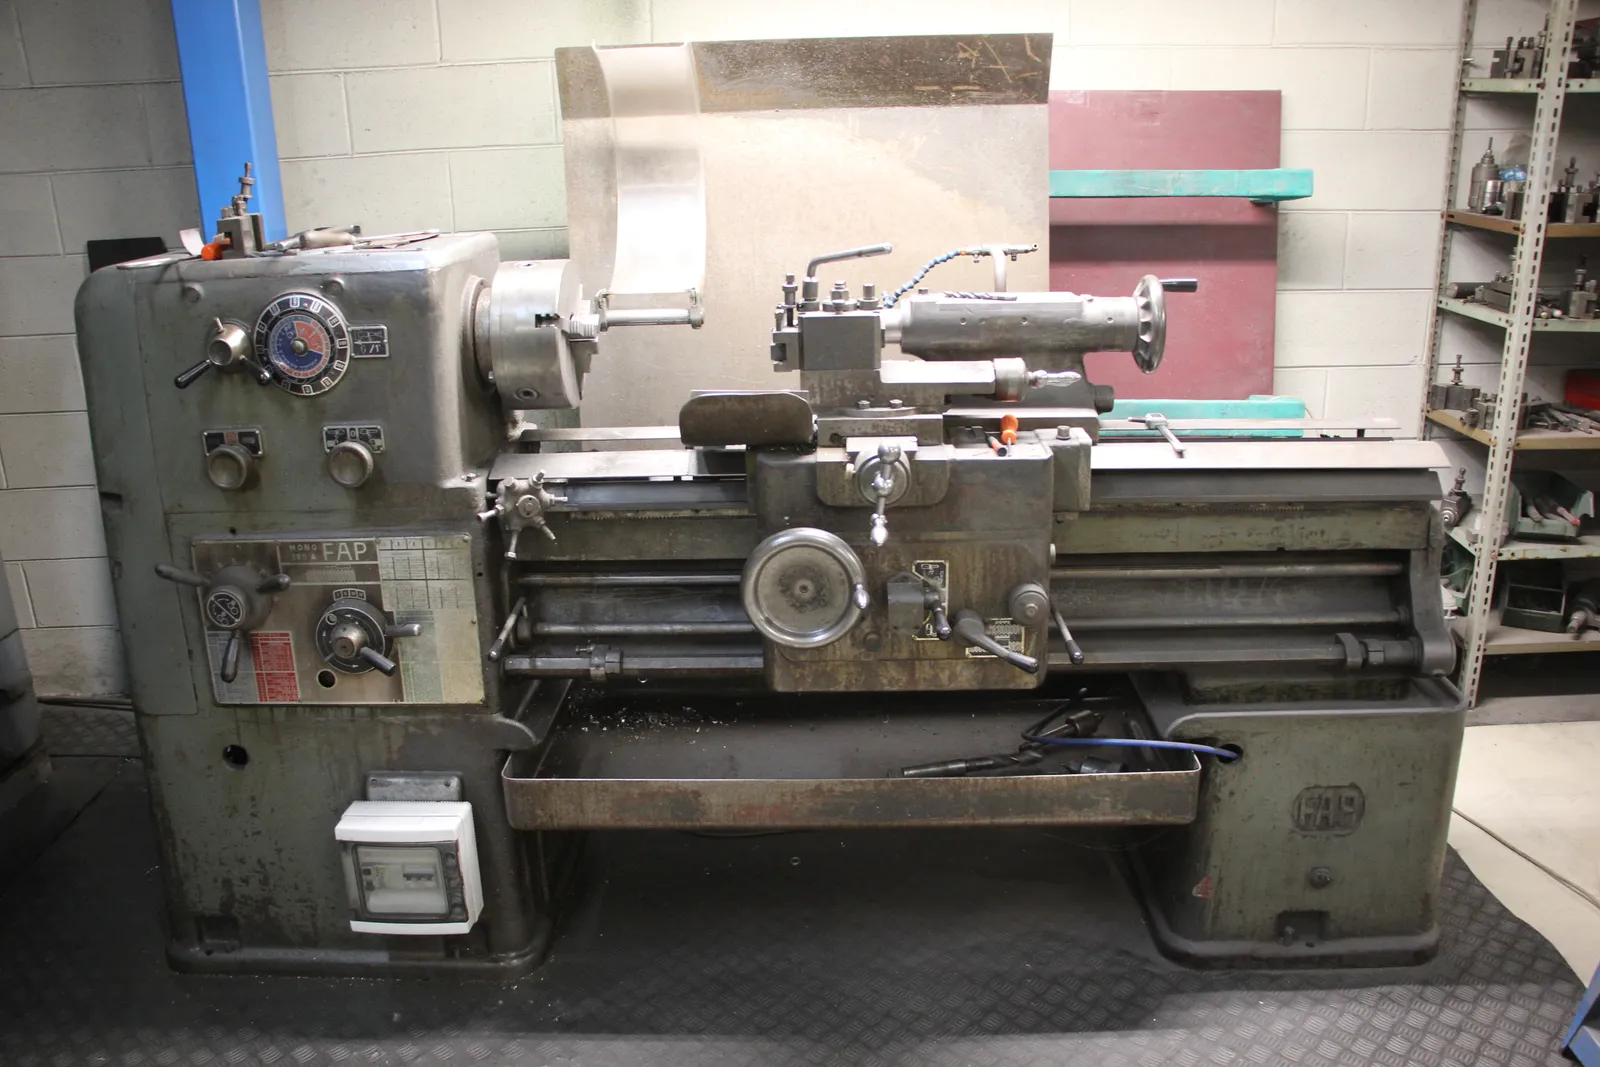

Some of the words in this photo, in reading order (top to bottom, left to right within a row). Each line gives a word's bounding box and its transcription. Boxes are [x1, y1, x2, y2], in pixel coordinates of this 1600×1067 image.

[288, 543, 318, 552] MONO
[322, 542, 367, 561] FAP
[1299, 792, 1359, 828] FAP
